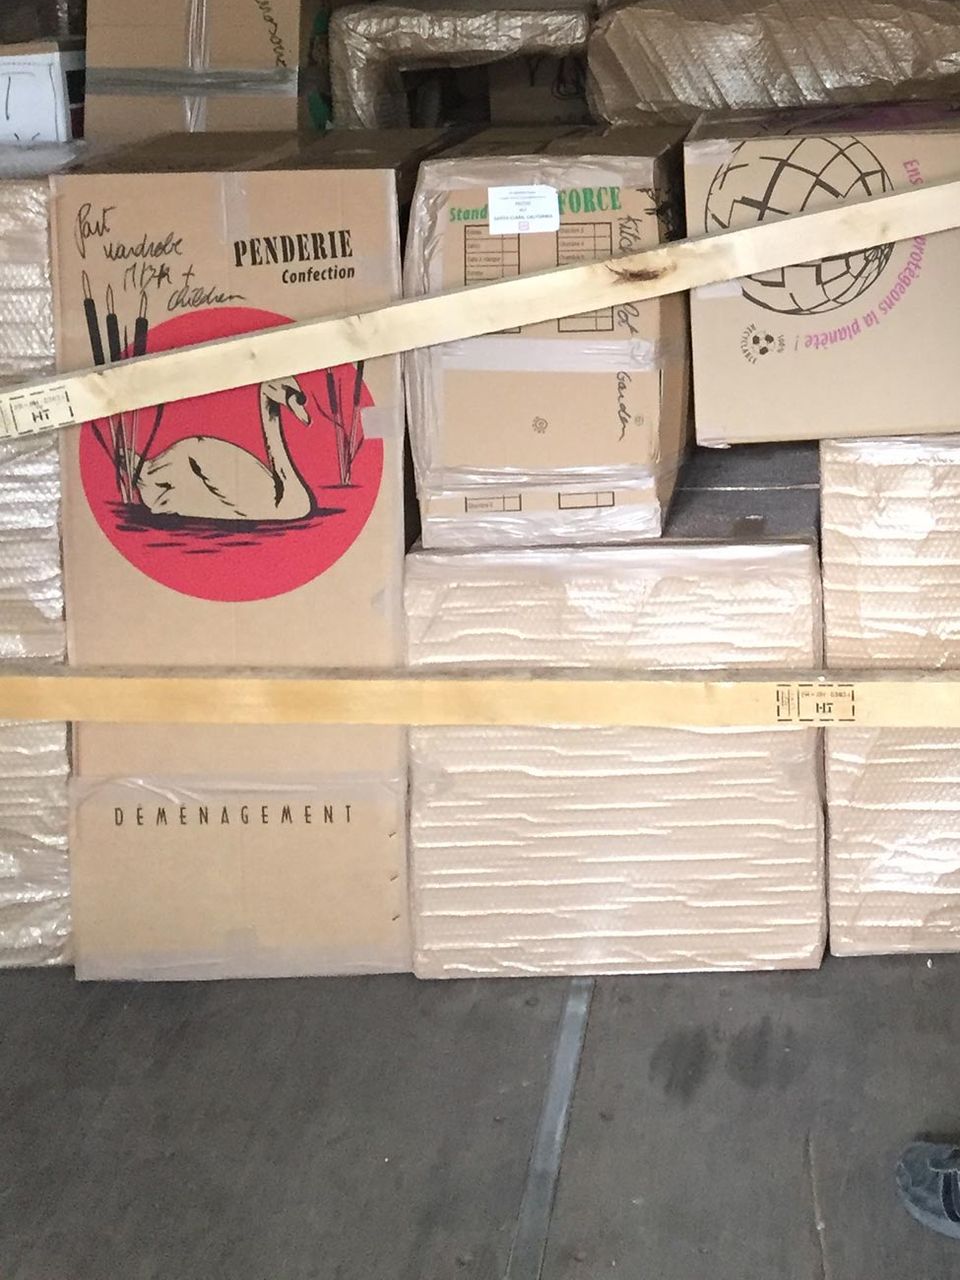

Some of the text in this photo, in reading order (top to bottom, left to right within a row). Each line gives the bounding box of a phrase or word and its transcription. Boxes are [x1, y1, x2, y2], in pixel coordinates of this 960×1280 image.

[449, 204, 488, 222] Stand
[558, 186, 622, 216] FORCE
[234, 229, 353, 267] PENDERIE
[282, 267, 355, 284] Confection
